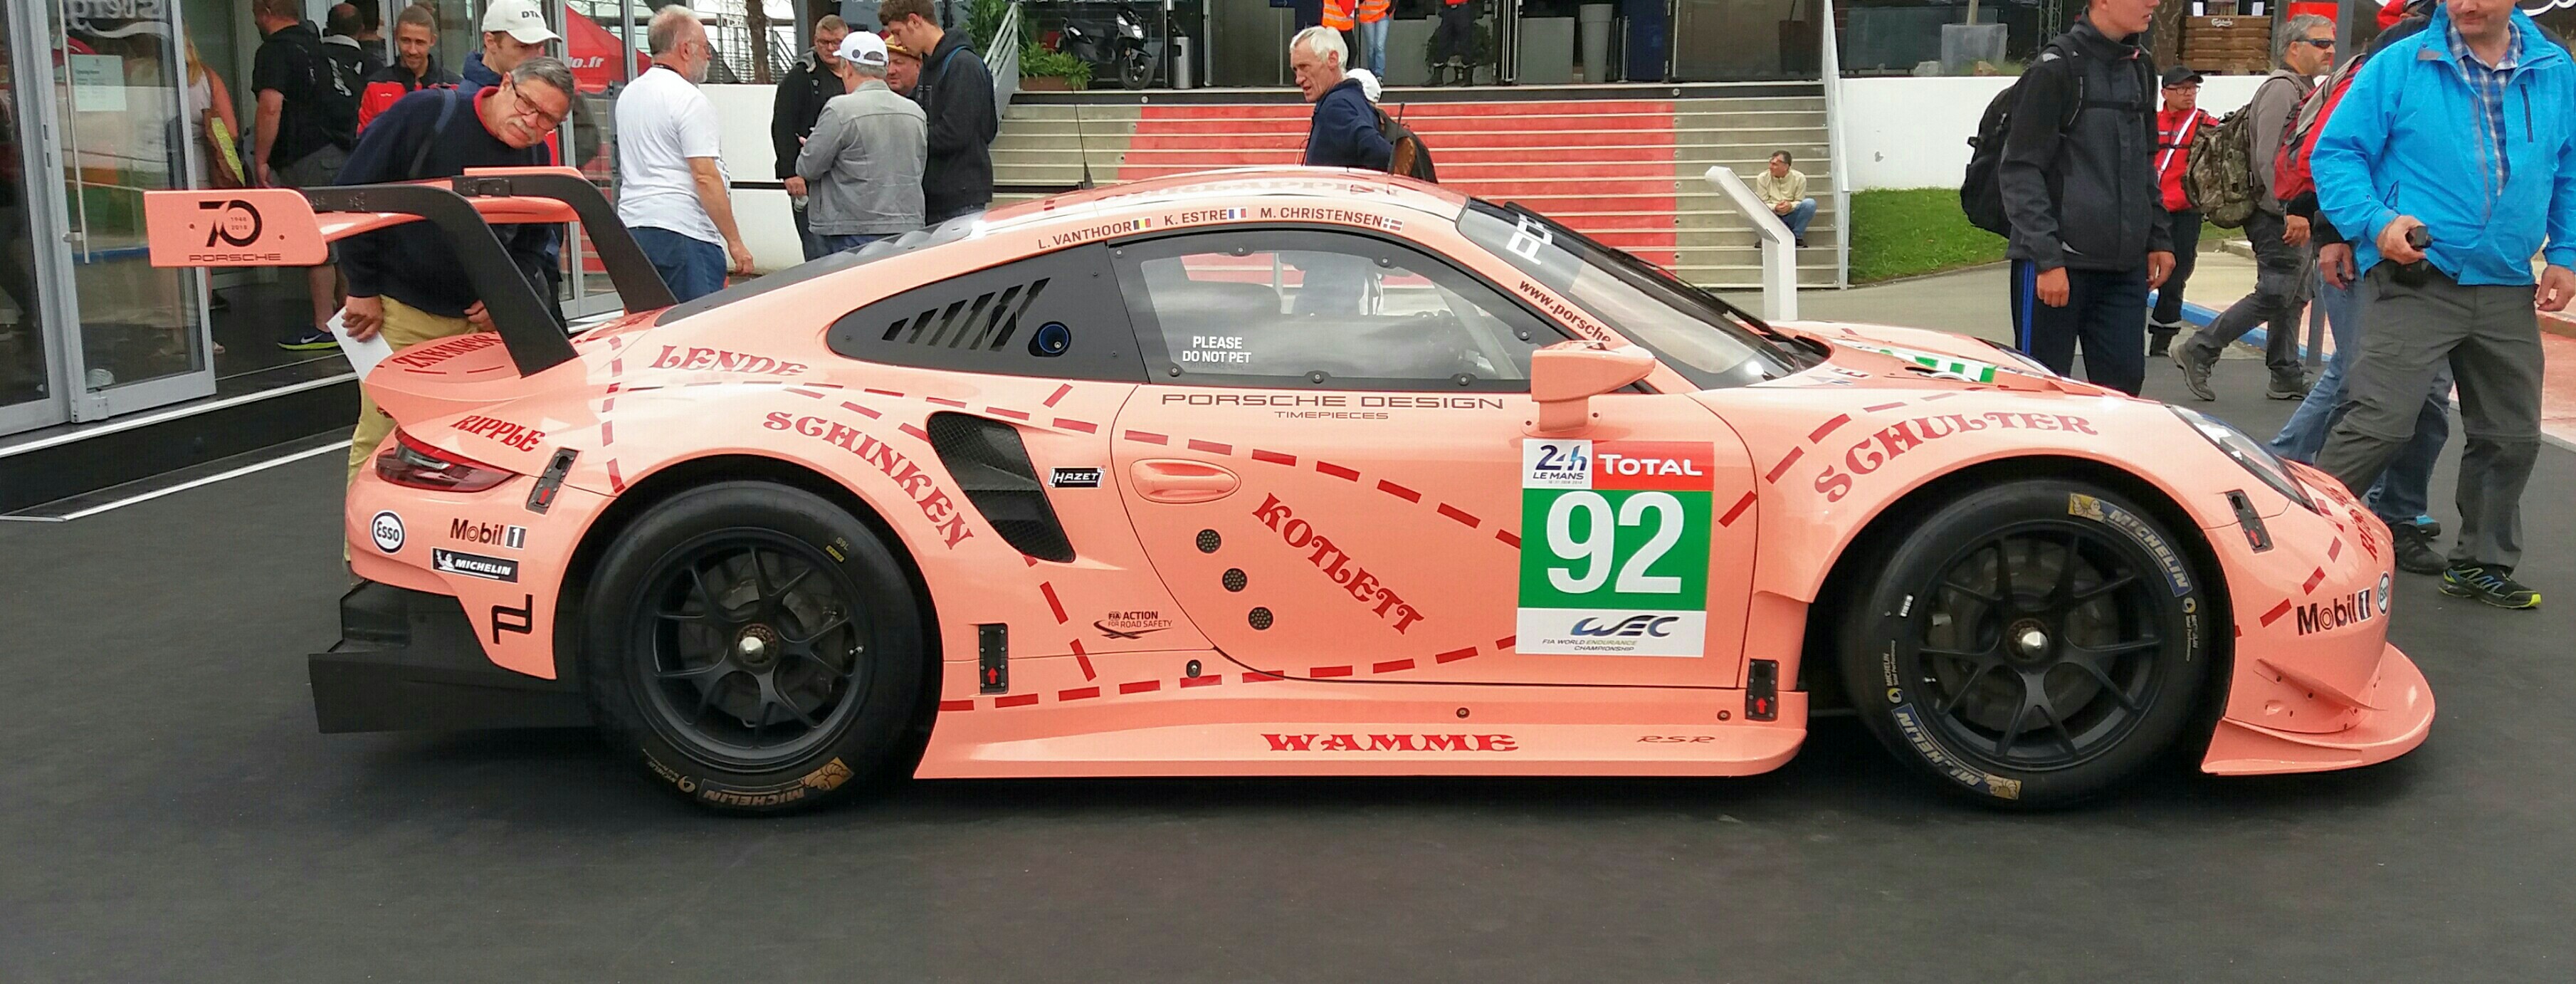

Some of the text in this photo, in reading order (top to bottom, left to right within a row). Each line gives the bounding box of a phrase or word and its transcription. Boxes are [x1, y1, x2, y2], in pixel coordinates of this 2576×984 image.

[199, 200, 262, 247] 70
[1038, 206, 1382, 249] L. VANTHOOR K. ESTRE M. CHRISTENSEN
[189, 253, 280, 262] PORSCHE
[1193, 336, 1242, 349] PLEASE
[648, 345, 808, 377] LENDE
[1182, 350, 1251, 363] DO NOT PET
[1162, 394, 1504, 410] PORSCHE DESIGN
[1274, 411, 1389, 419] TIMEPIECES
[1598, 454, 1703, 476] TOTAL
[1814, 412, 2098, 503] SCHULTER
[762, 411, 974, 550] SCHINKEN
[1054, 473, 1098, 483] HAZET
[377, 520, 399, 543] Esso
[450, 518, 503, 545] Mobil
[1546, 491, 1684, 594] 92
[2110, 510, 2189, 588] MICHELIN
[455, 559, 511, 576] MICHELIN
[1253, 493, 1424, 635] KOTLETT
[2296, 590, 2357, 636] Mobil
[1570, 615, 1679, 637] WEC
[1261, 733, 1518, 752] WAMME
[703, 787, 805, 806] MICHELIN
